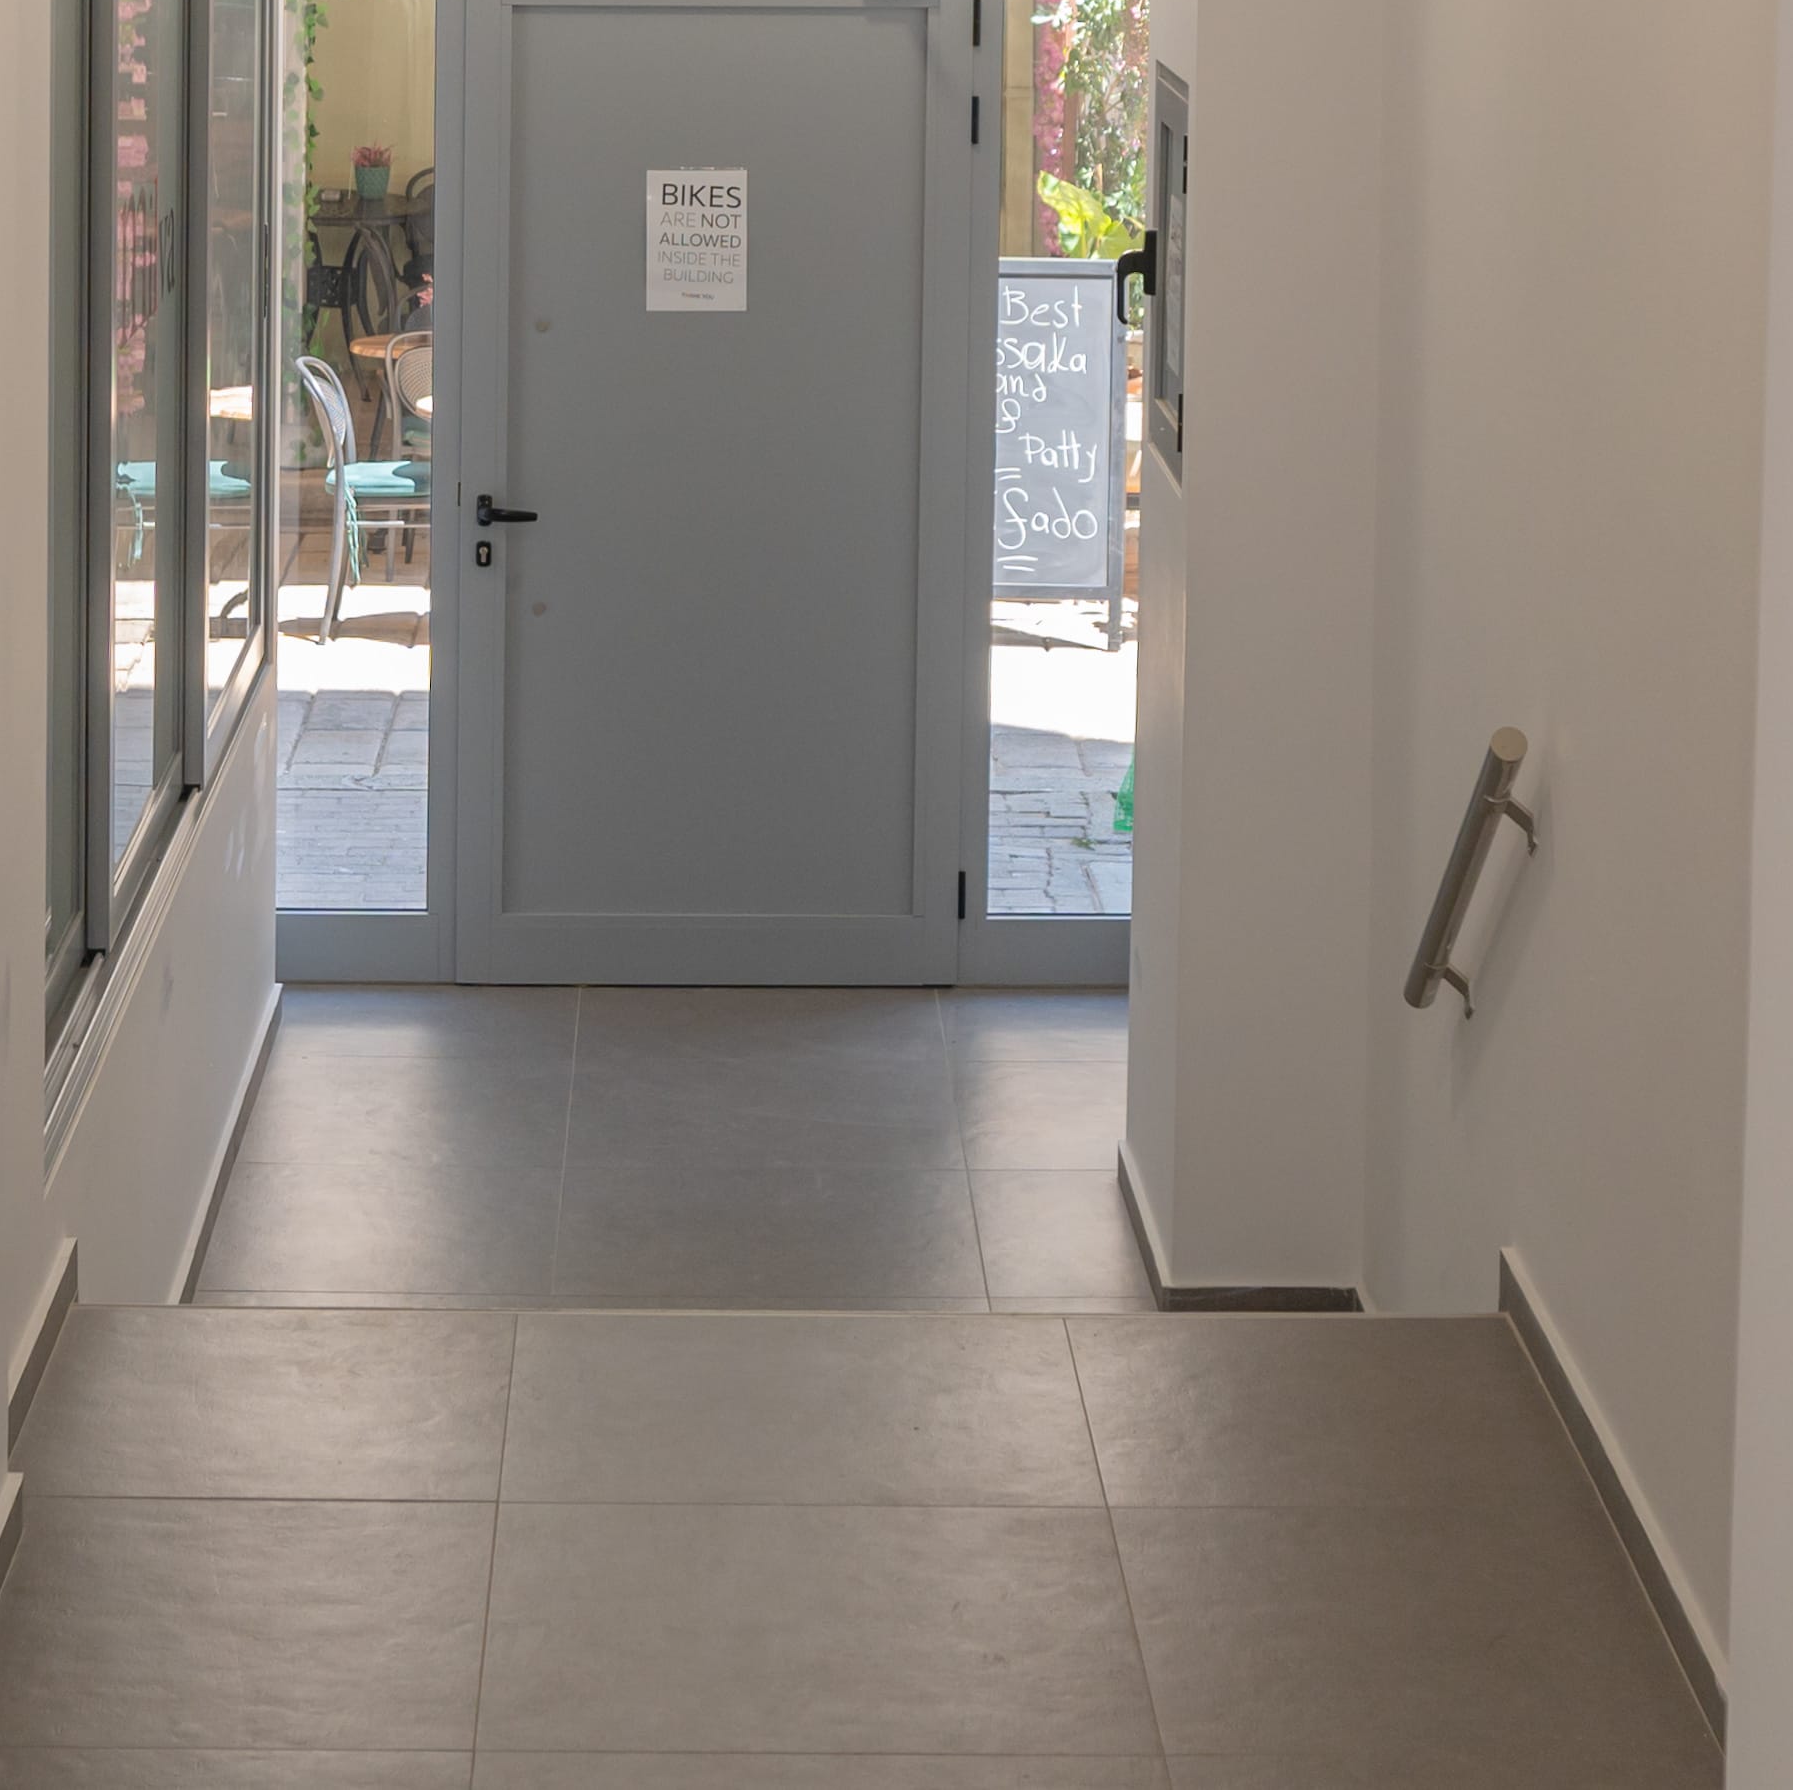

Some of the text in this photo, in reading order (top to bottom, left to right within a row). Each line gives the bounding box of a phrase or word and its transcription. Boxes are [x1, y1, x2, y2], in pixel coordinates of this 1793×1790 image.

[662, 183, 742, 209] BIKES
[660, 211, 742, 230] ARE NOT
[659, 232, 742, 249] ALLOWED
[657, 250, 741, 268] INSIDE THE
[663, 268, 735, 285] BUILDING
[999, 285, 1083, 329] Best
[1018, 429, 1098, 483] Patty
